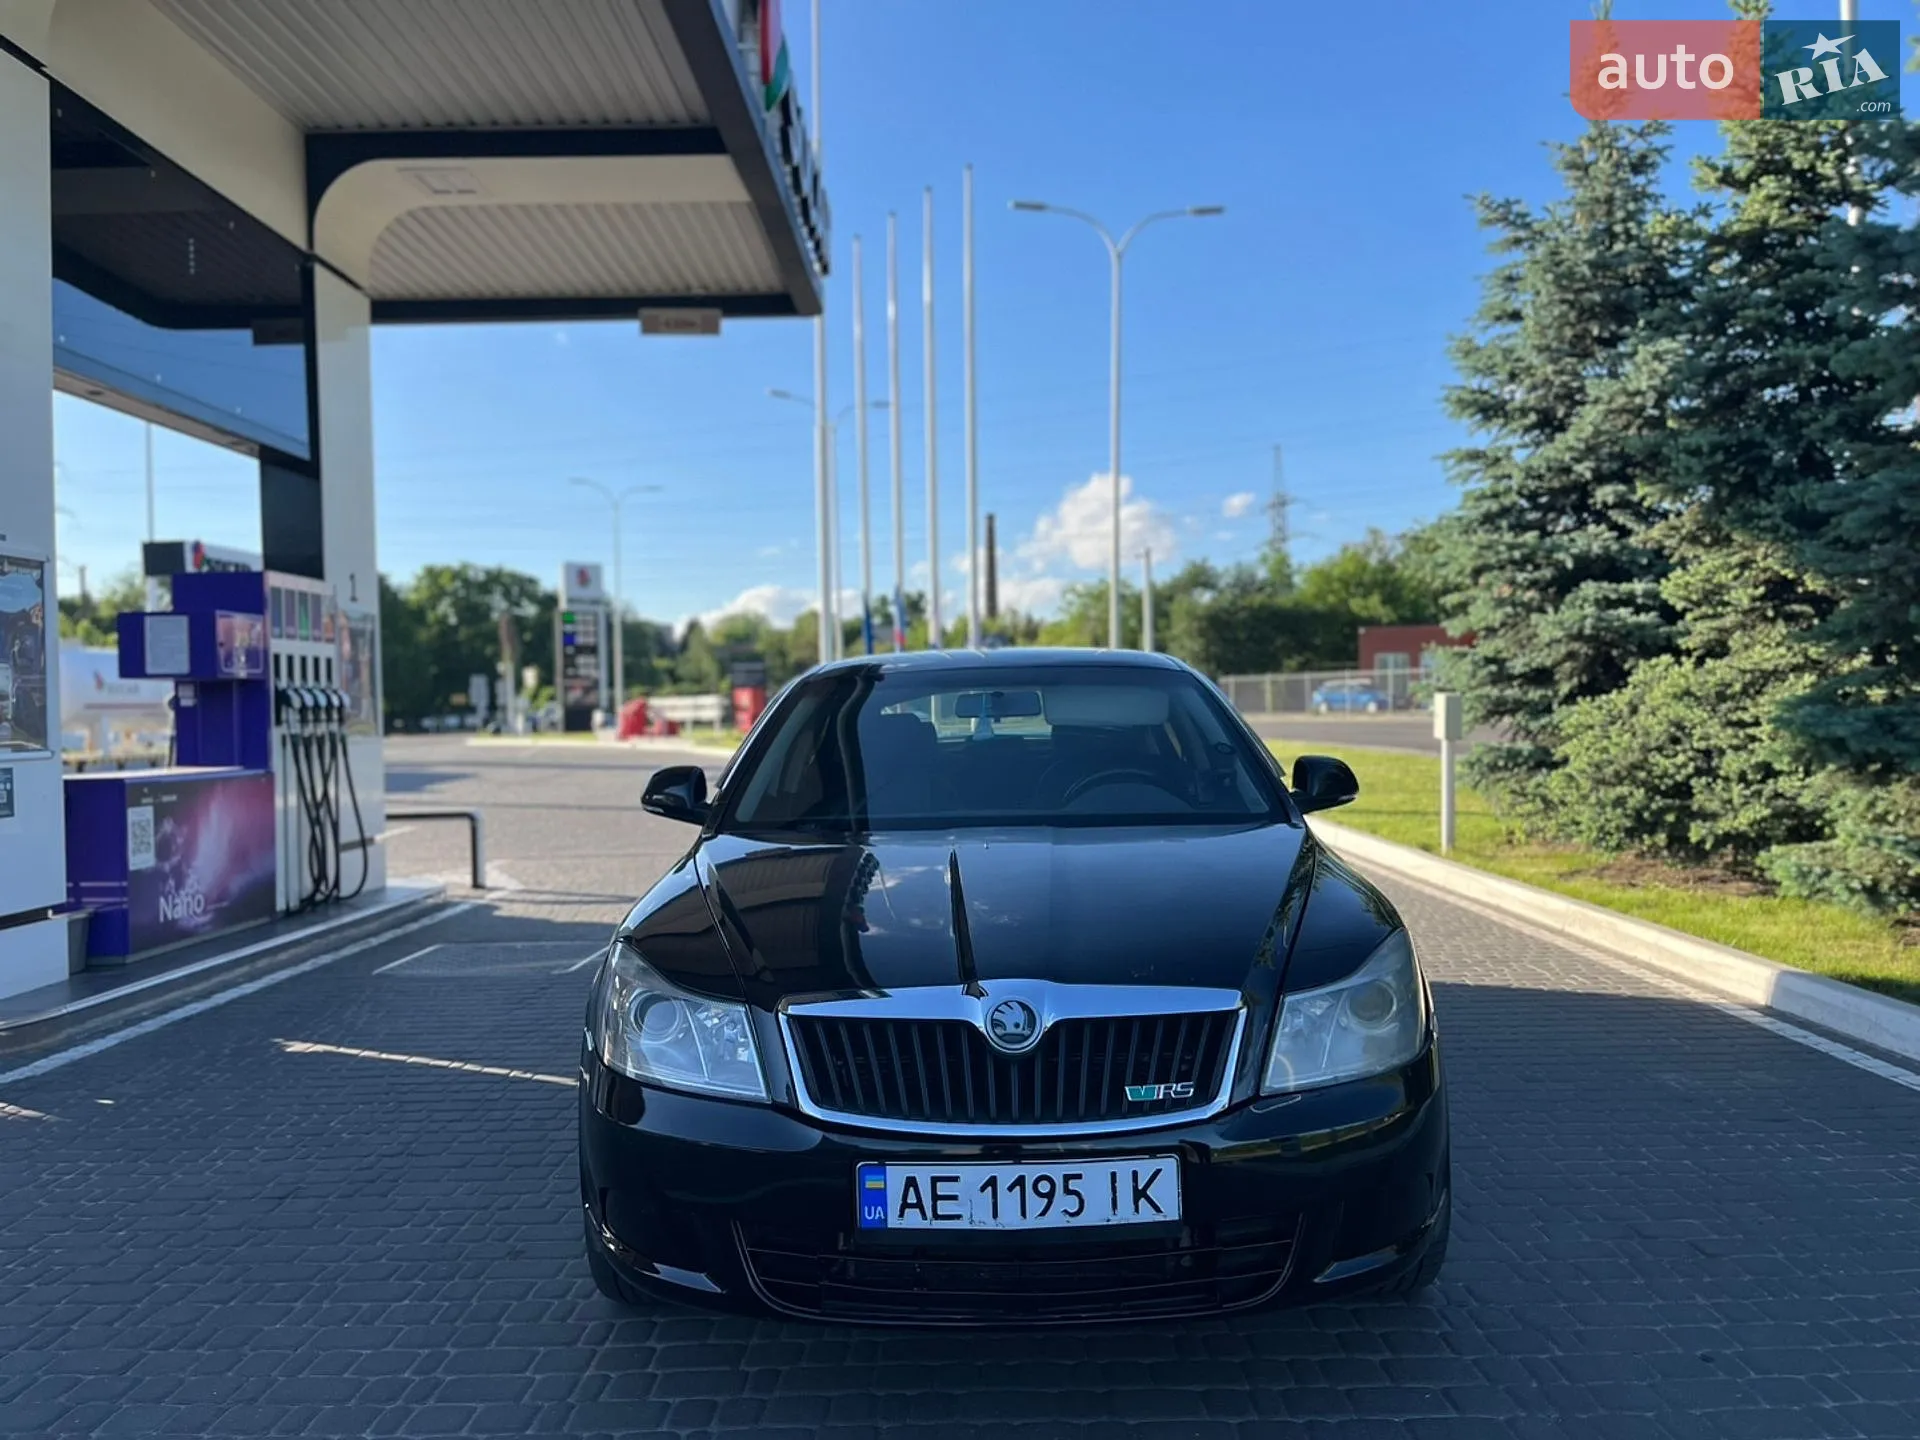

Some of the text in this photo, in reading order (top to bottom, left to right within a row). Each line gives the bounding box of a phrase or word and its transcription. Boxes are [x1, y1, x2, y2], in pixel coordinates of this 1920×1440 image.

[348, 573, 358, 602] 1
[159, 894, 205, 923] Nano
[897, 1167, 1164, 1221] AE 1195 IK
[864, 1205, 885, 1220] UA
